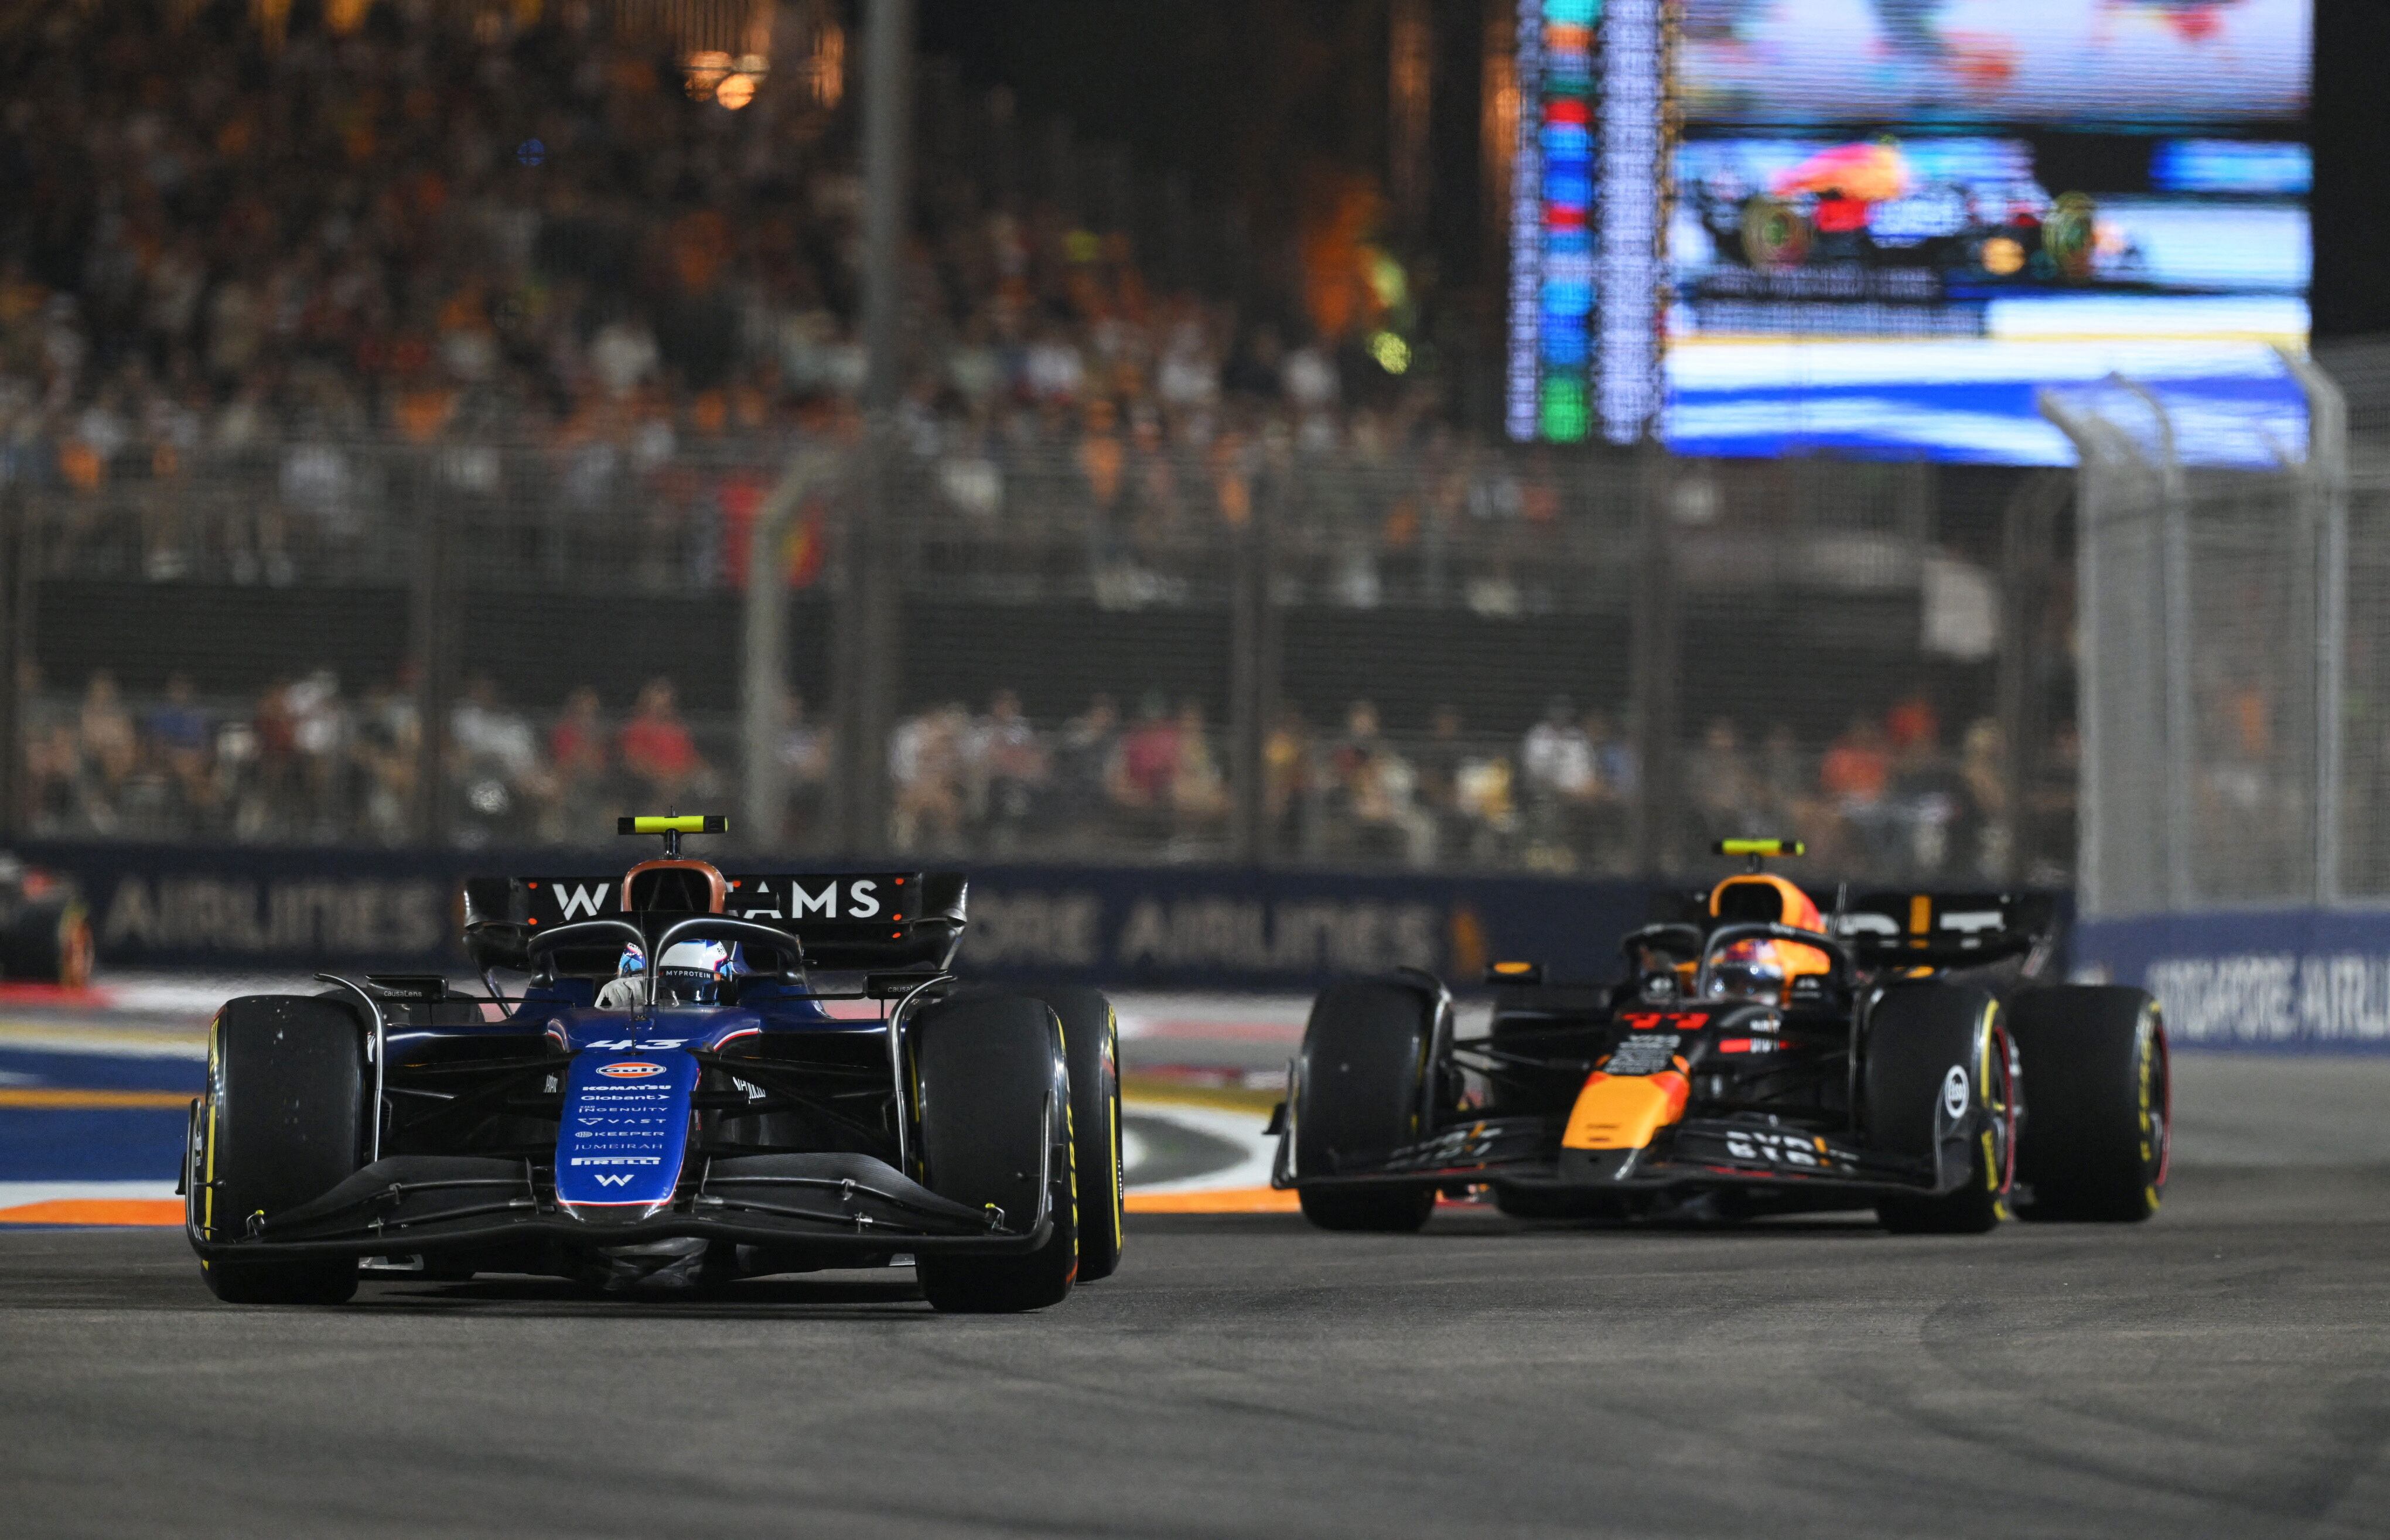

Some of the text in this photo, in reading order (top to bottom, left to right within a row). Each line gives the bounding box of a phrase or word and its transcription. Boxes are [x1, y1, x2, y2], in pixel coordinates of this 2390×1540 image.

[666, 970, 711, 979] MYPROTEIN
[585, 1039, 689, 1050] 43
[571, 1156, 661, 1166] PIRELLI
